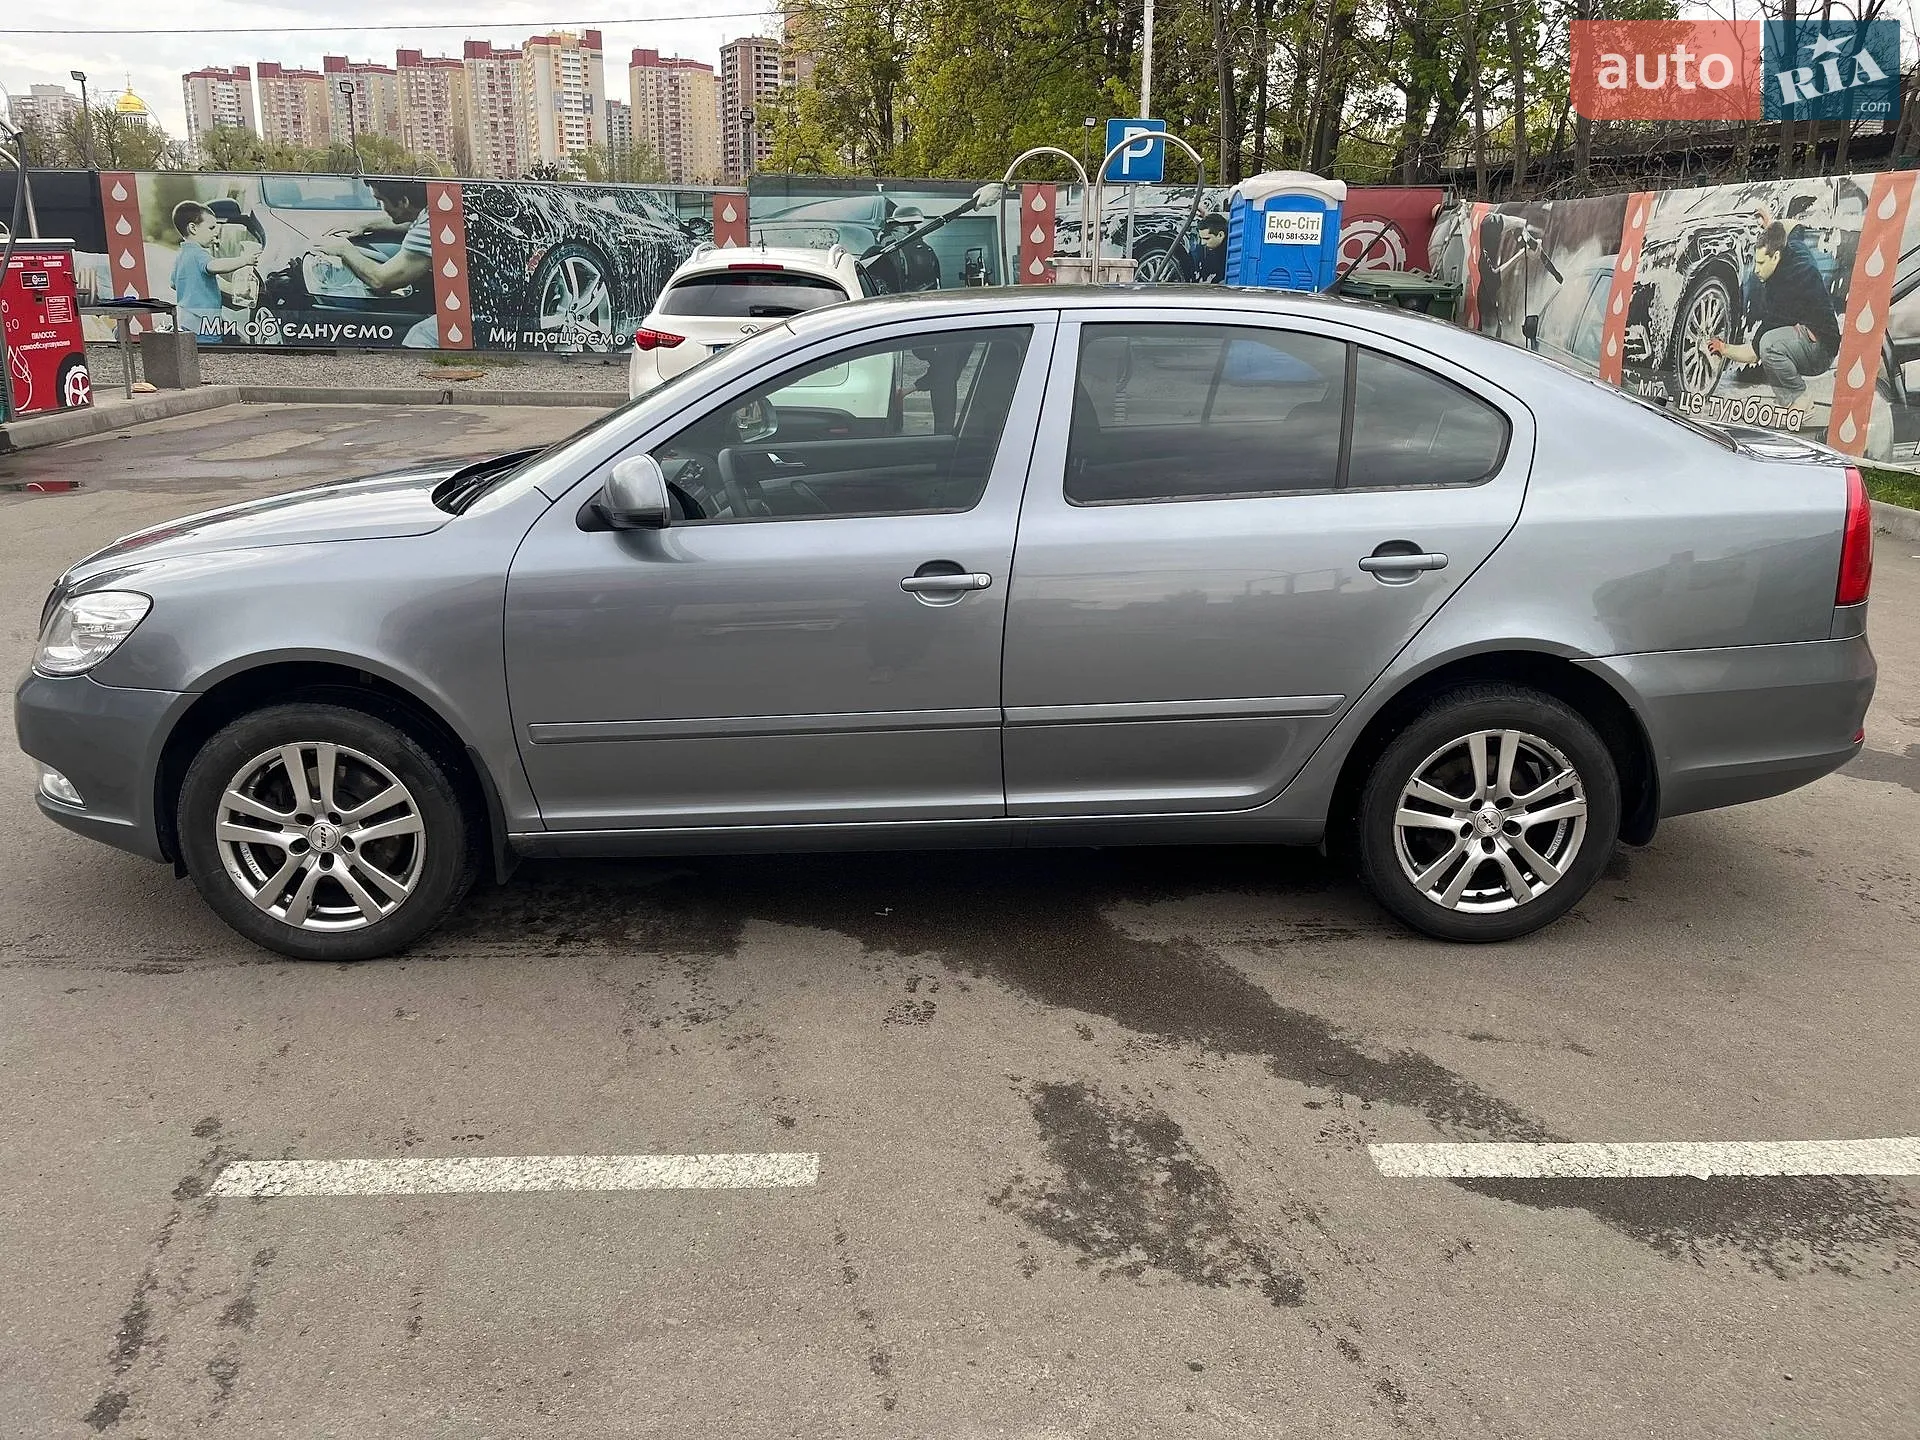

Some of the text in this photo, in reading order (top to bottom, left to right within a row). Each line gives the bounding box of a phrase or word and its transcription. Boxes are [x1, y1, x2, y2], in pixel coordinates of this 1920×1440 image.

[1122, 127, 1154, 175] P
[1268, 215, 1320, 230] Еко-Сіті
[1267, 231, 1319, 241] (044) 581-53-22
[200, 316, 394, 342] Ми об'єднуємо
[488, 327, 626, 347] Ми працюємо
[1678, 391, 1704, 415] це
[1708, 395, 1804, 433] турбота
